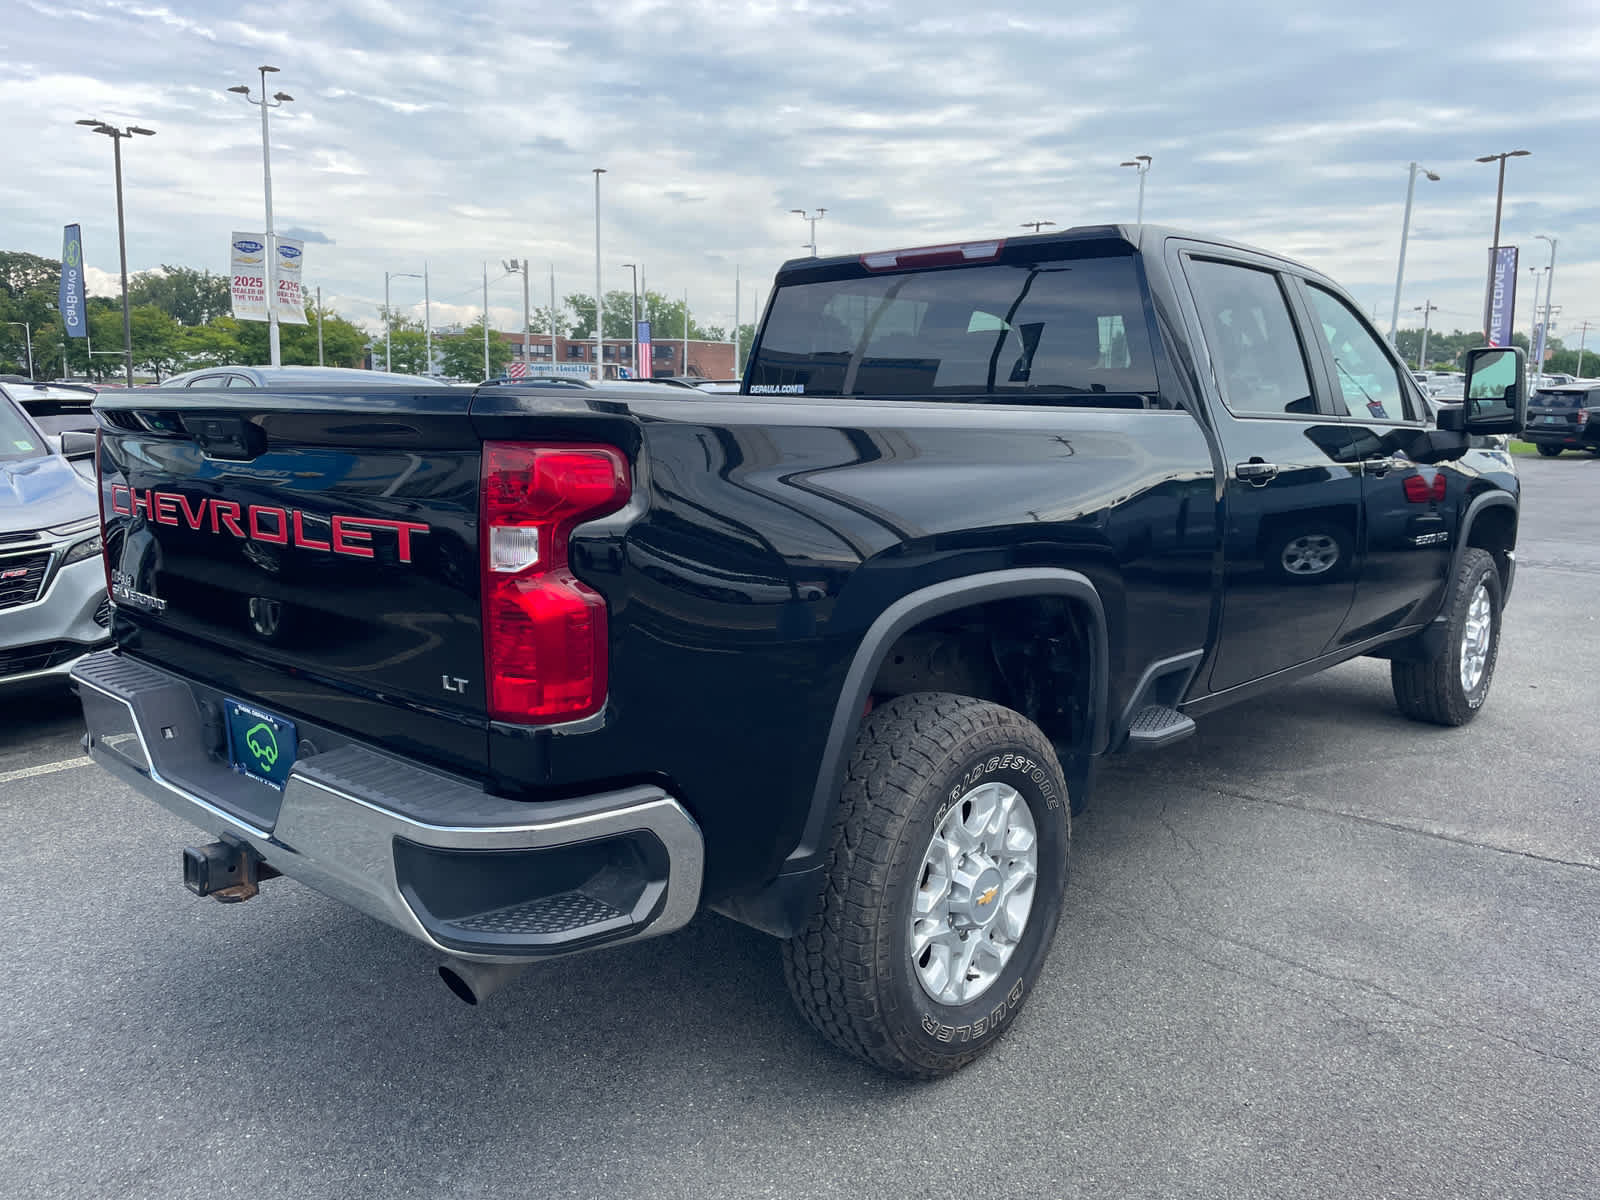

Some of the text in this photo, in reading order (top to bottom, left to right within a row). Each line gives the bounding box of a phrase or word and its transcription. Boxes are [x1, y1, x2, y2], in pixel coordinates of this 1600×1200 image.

[234, 275, 263, 288] 2025
[232, 287, 256, 295] DEALER
[750, 384, 798, 394] DEPAULA.COM
[111, 484, 431, 564] CHEVROLET
[442, 675, 469, 693] LT
[933, 753, 1060, 829] BRIDGESTONE
[921, 976, 1024, 1043] DUELER
